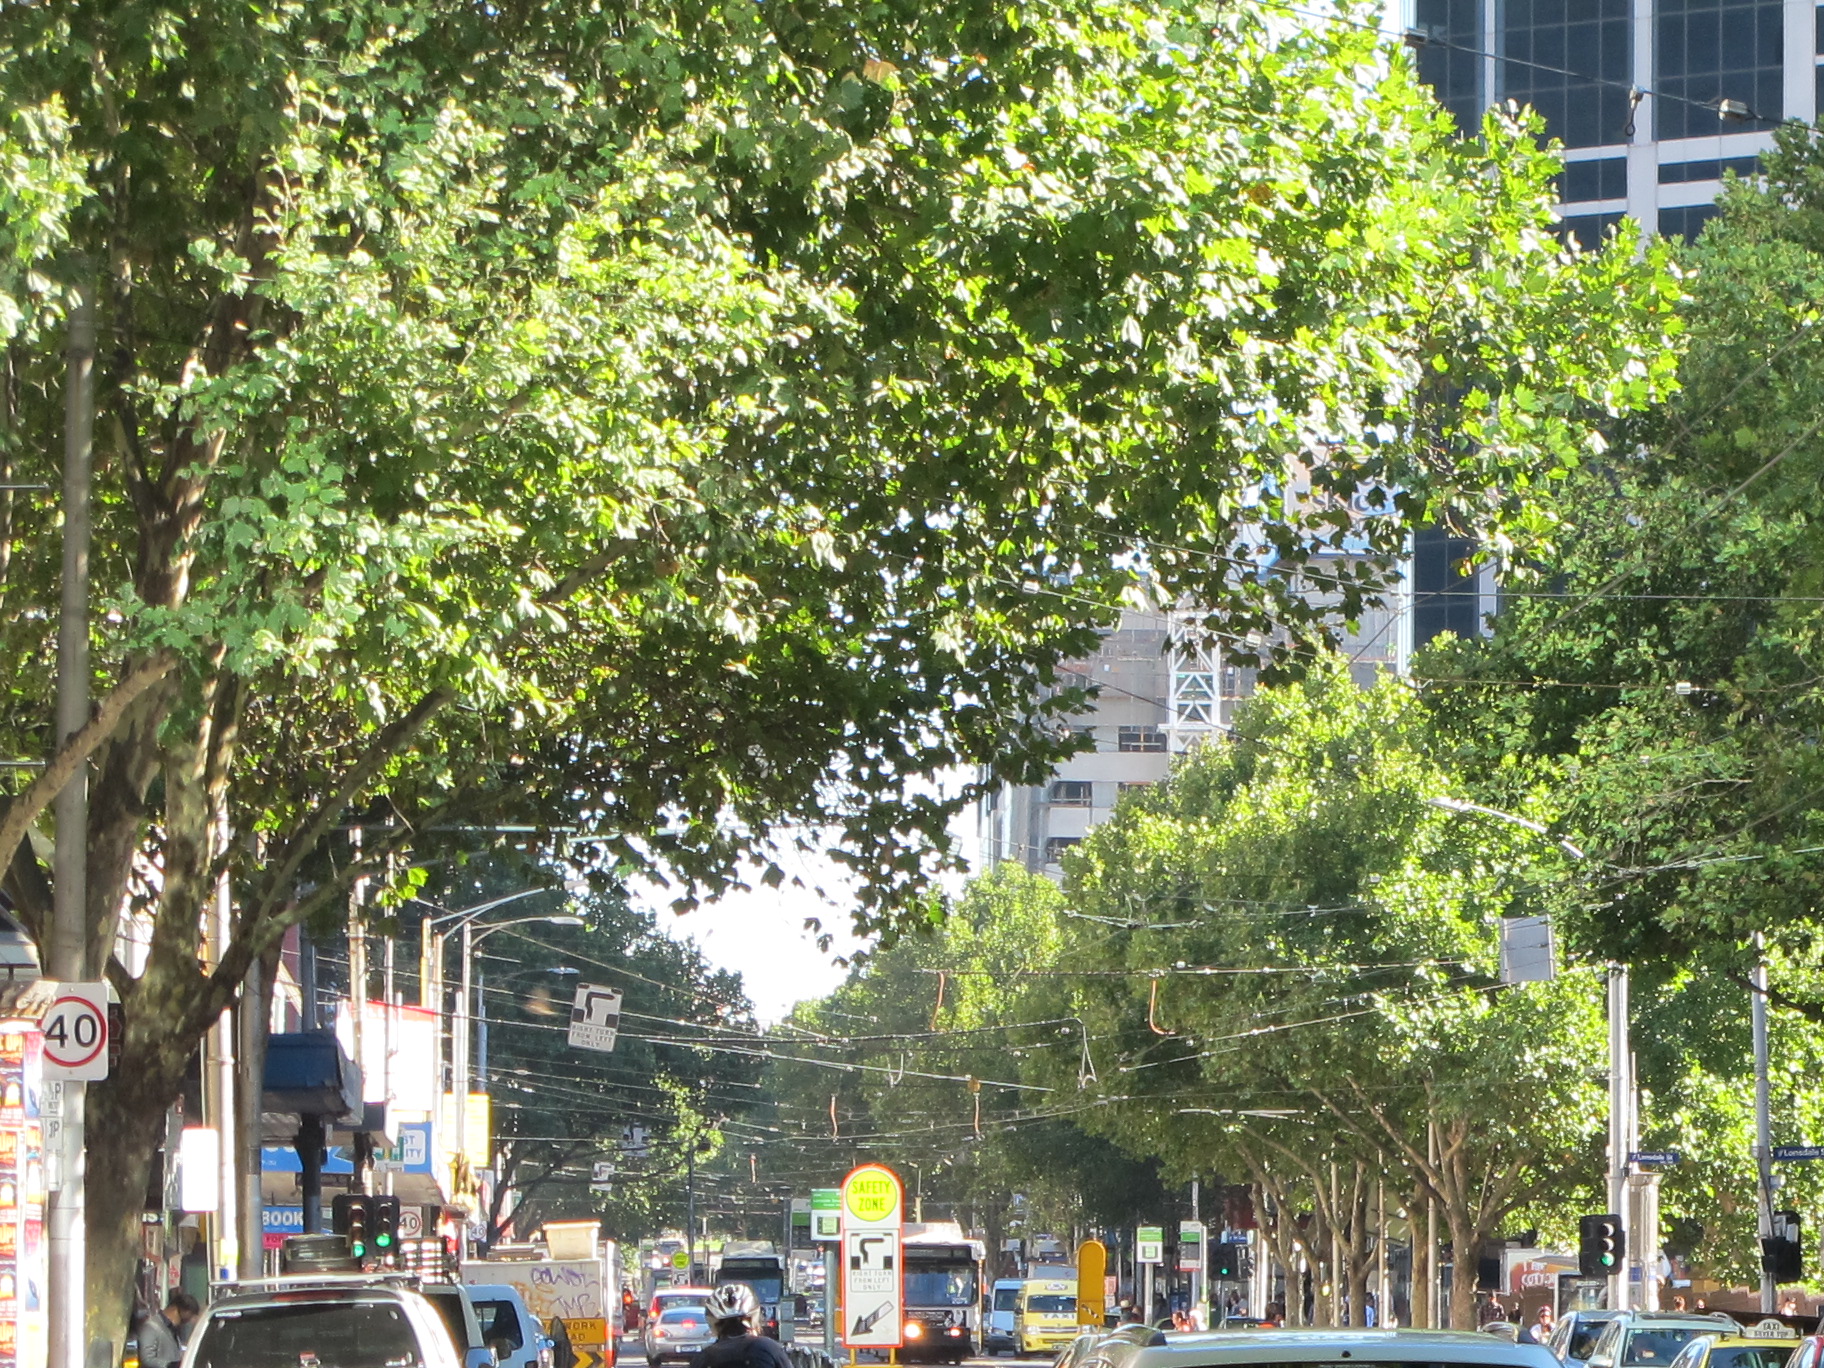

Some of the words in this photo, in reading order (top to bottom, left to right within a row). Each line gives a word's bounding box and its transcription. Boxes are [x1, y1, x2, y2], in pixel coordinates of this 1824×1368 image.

[45, 1014, 97, 1048] 40
[1784, 1148, 1819, 1157] Lonsdale
[852, 1181, 891, 1194] SAFETY
[858, 1197, 886, 1211] ZONE
[402, 1217, 417, 1229] 40
[1042, 1312, 1076, 1320] TAXI
[1763, 1322, 1780, 1331] TAXI
